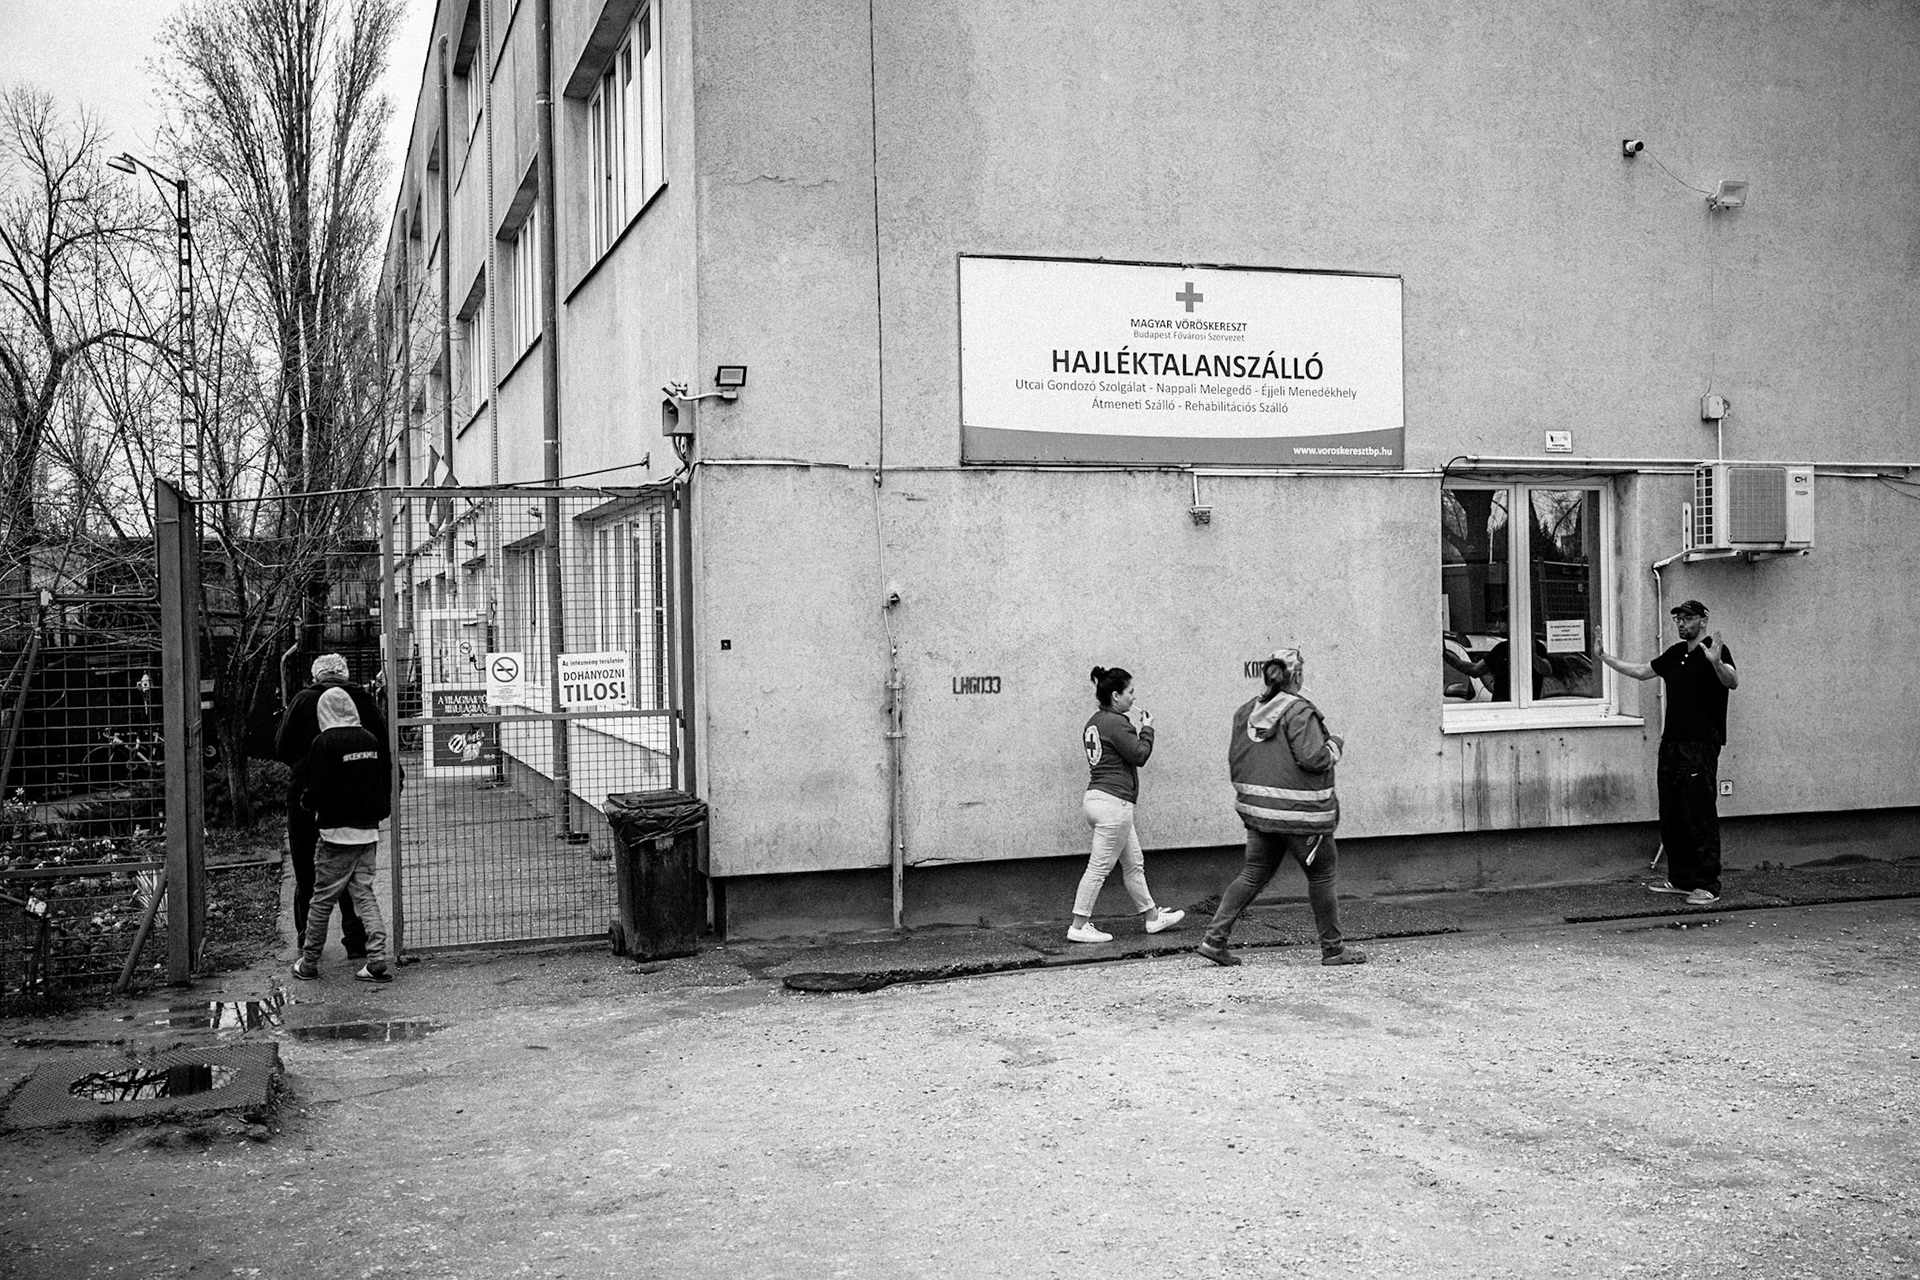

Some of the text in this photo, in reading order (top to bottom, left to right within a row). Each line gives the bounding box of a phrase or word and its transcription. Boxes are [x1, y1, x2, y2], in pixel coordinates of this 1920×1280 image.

[1130, 318, 1247, 332] MAGYAR VÖRÖSKERESZT
[1133, 330, 1245, 342] Budapest Fővárosi Szervezet
[1052, 345, 1324, 380] HAJLÉKTALANSZÁLLÓ
[1015, 379, 1044, 390] Utcai
[1047, 379, 1096, 391] Gondozó
[1099, 380, 1147, 394] Szolgálat
[1156, 383, 1197, 396] Nappali
[1200, 384, 1252, 398] Melegedő
[1261, 383, 1286, 398] Éjjeli
[1288, 386, 1357, 400] Menedékhely
[1091, 396, 1142, 410] Átmeneti
[1144, 399, 1175, 411] Szálló
[1185, 400, 1257, 413] Rehabilitációs
[1259, 402, 1289, 414] Szálló
[1293, 446, 1393, 457] www.voroskeresztbp.hu
[563, 681, 626, 702] TILOS!
[952, 676, 1001, 694] LHG033
